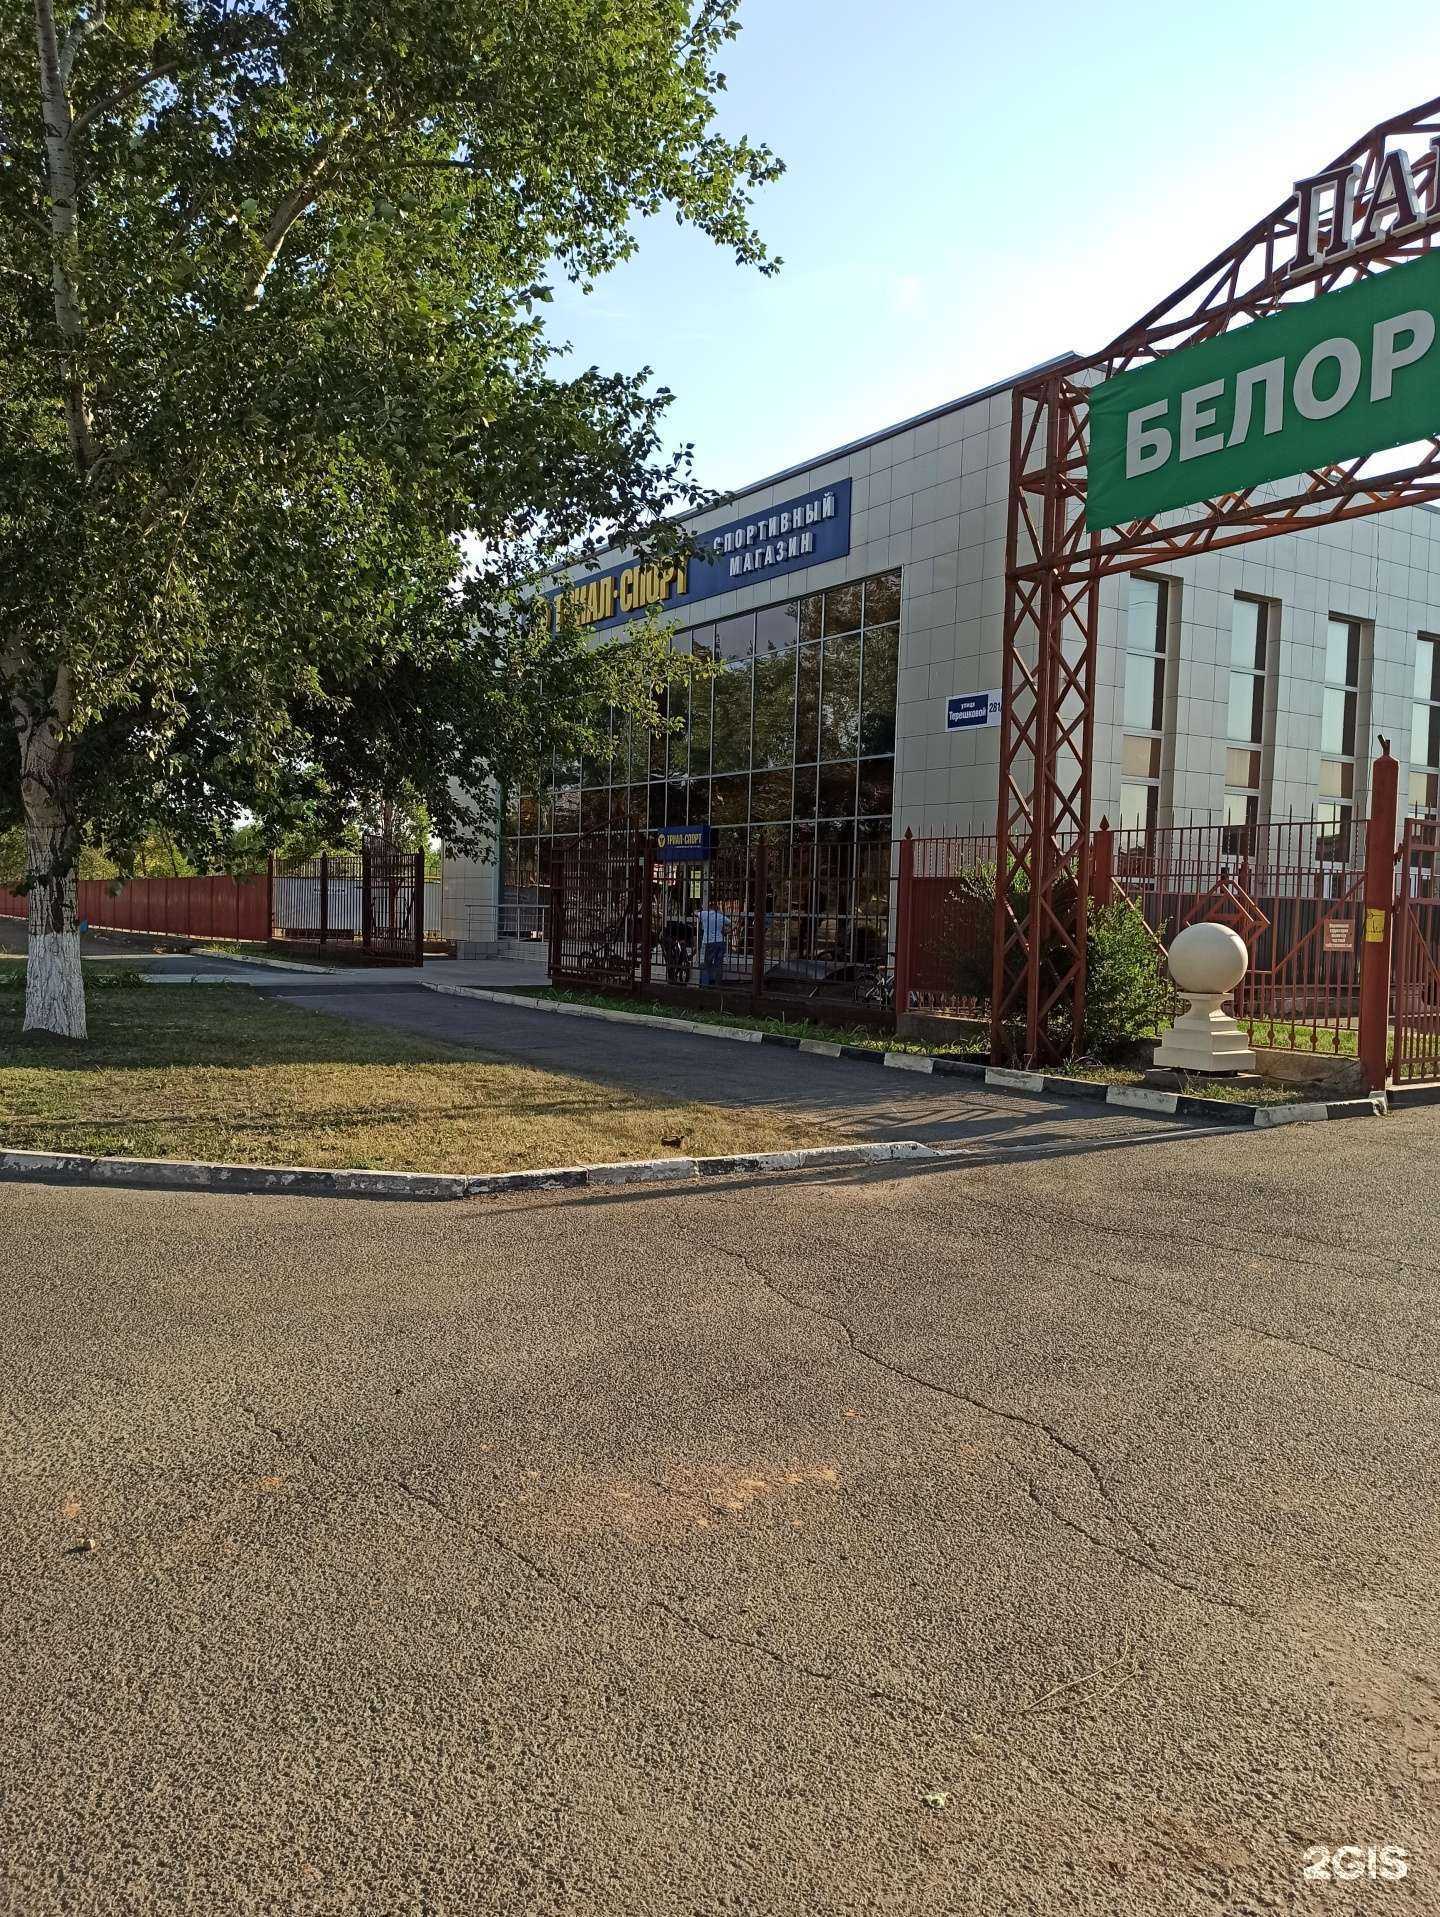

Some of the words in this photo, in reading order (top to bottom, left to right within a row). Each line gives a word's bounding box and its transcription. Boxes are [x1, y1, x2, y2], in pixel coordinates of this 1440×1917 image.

[1288, 137, 1440, 278] ПА
[1126, 310, 1436, 479] БЕЛОР
[713, 492, 835, 554] СПОРТИВНЫЙ
[729, 532, 814, 577] МАГАЗИН
